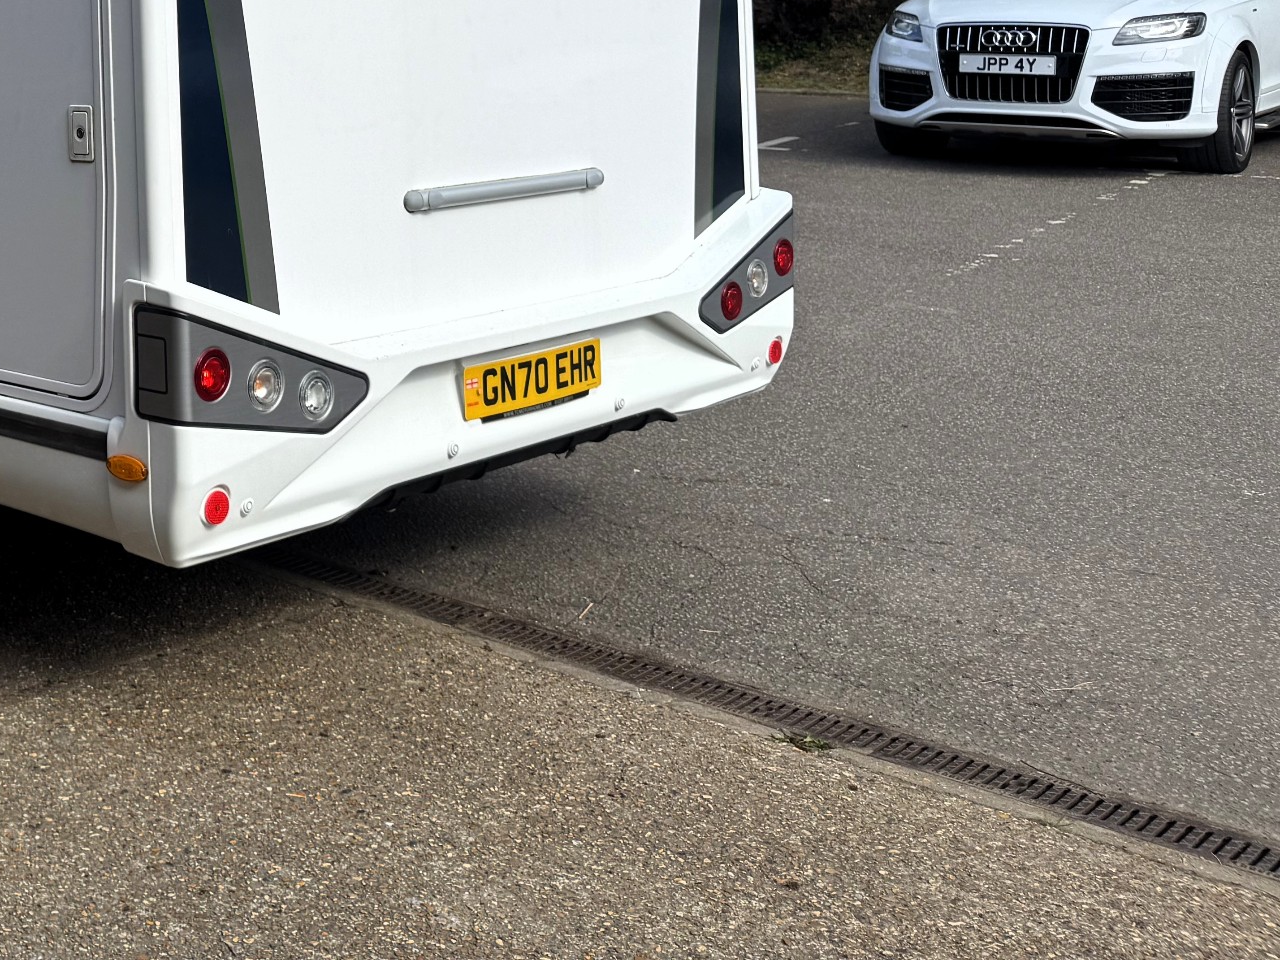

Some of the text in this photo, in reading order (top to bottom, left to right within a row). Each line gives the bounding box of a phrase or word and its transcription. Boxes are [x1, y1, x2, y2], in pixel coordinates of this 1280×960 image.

[976, 57, 1037, 73] JPP 4Y
[482, 357, 549, 407] GN70
[555, 344, 597, 390] EHR
